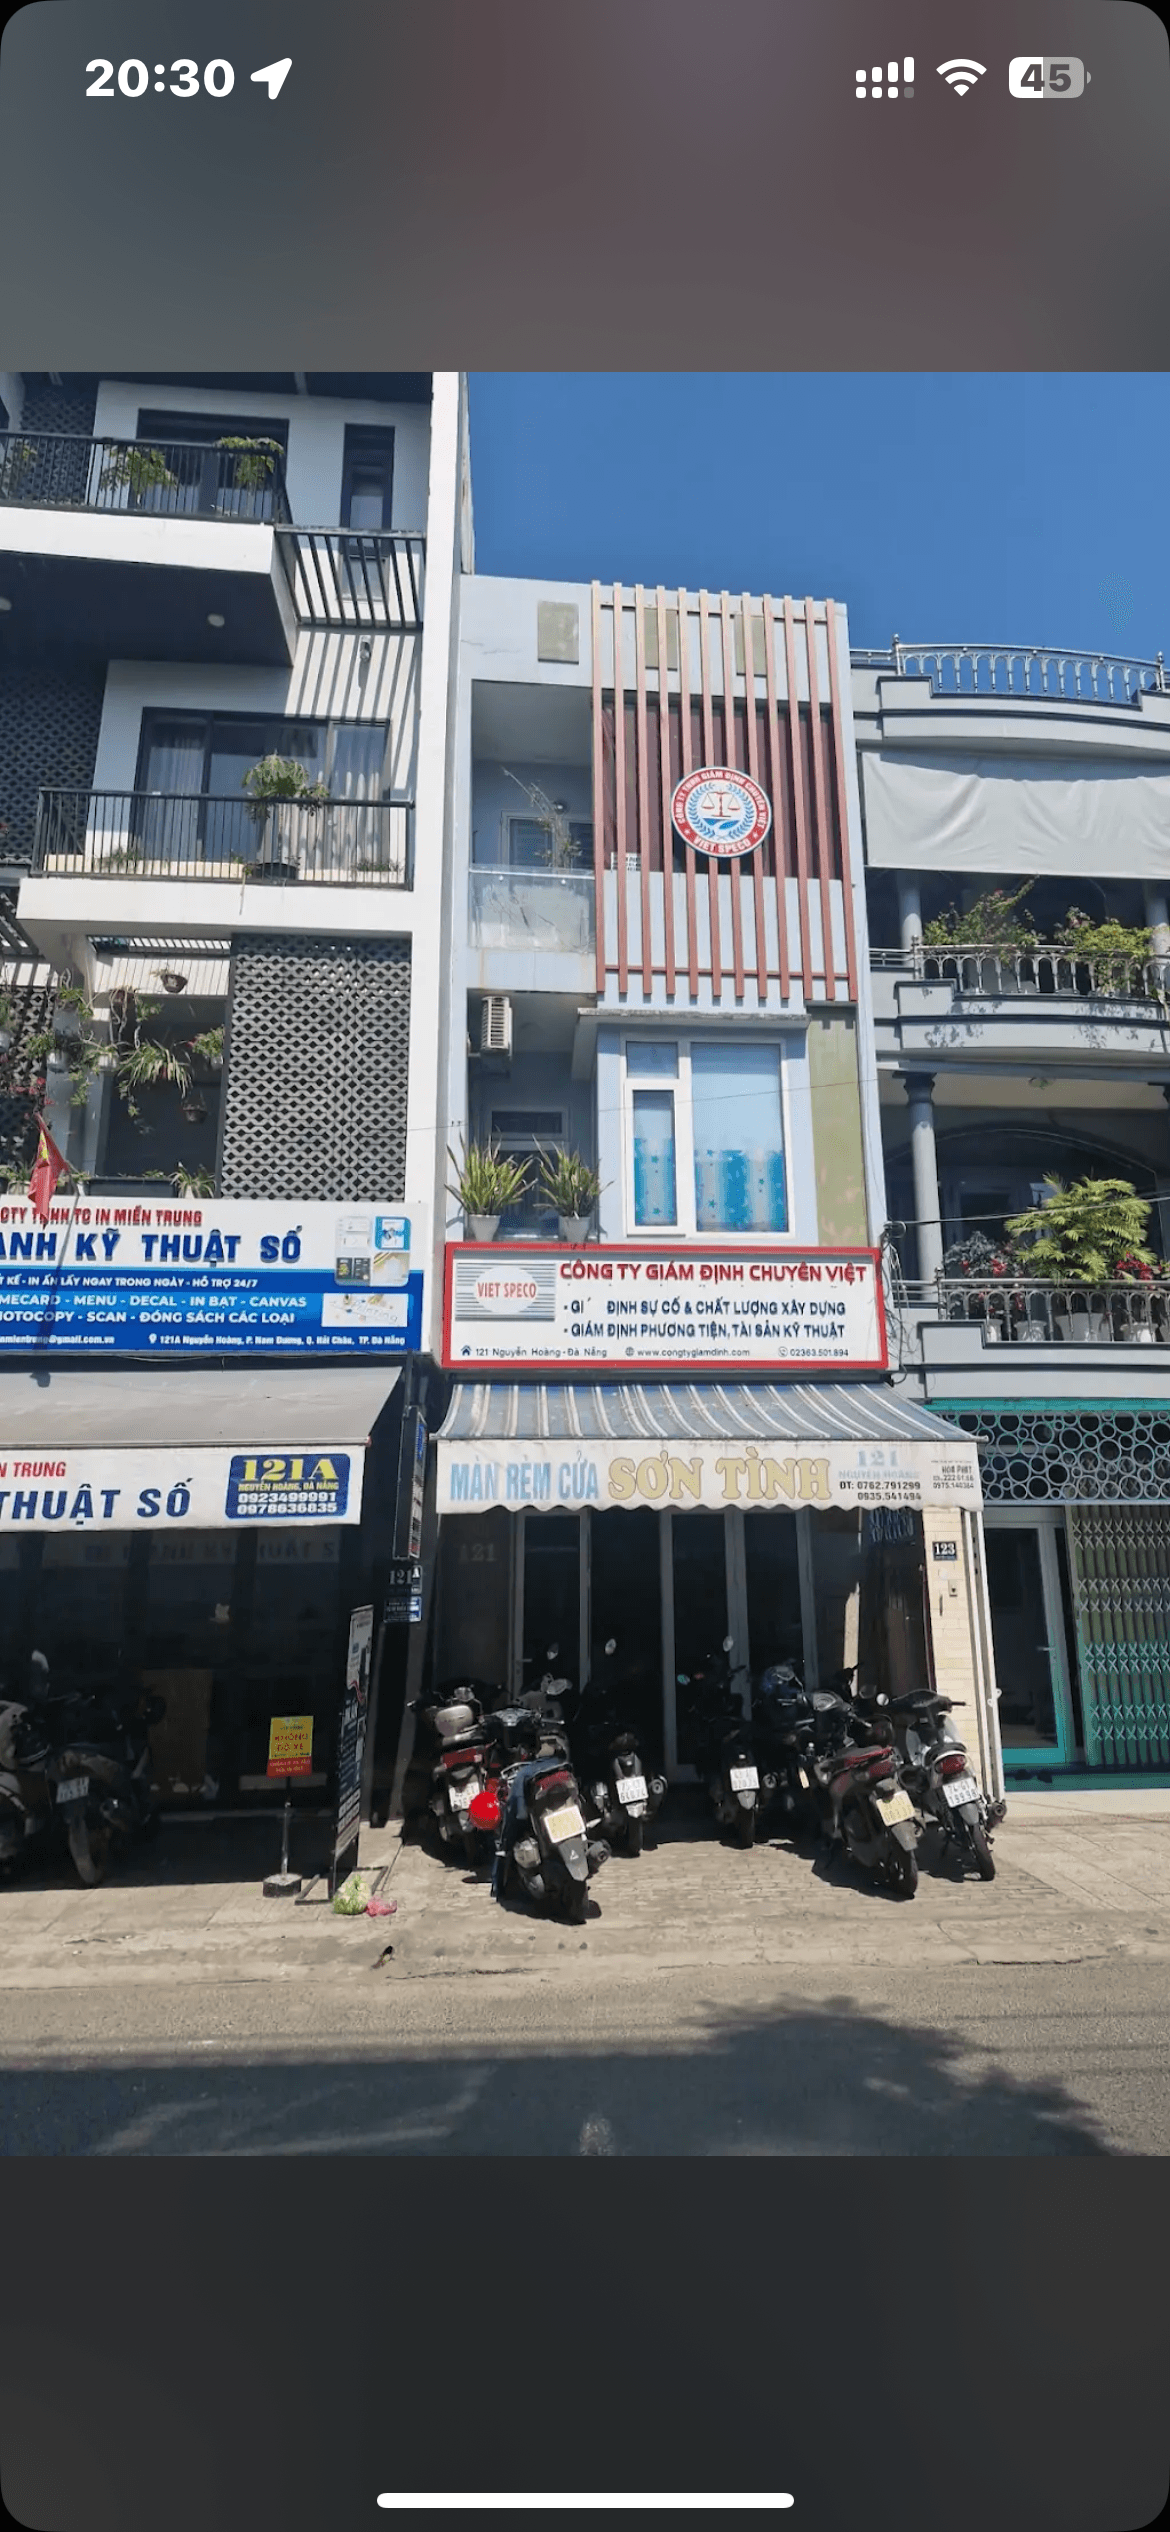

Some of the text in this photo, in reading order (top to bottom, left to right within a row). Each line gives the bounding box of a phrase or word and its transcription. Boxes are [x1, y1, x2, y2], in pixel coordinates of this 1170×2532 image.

[693, 835, 752, 854] VIET SPECO
[32, 1207, 70, 1224] THH
[95, 1208, 110, 1225] IN
[156, 1210, 203, 1227] TRUNG
[75, 1227, 121, 1261] KỸ
[141, 1228, 242, 1268] THUẬT
[260, 1224, 303, 1263] SỐ
[560, 1258, 867, 1286] CÔNG TY GIÁM ĐỊNH CHUYÊN VIỆT
[6, 1272, 22, 1286] KẾ
[28, 1276, 40, 1286] IN
[60, 1273, 80, 1287] LẤY
[82, 1277, 113, 1287] NGAY
[115, 1277, 151, 1288] TRONG
[153, 1275, 185, 1288] NGÀY
[211, 1278, 232, 1290] TRỢ
[233, 1278, 259, 1289] 24/7
[477, 1282, 537, 1298] VIET SPECO
[73, 1294, 118, 1306] MENU
[129, 1295, 178, 1307] DECAL
[189, 1296, 206, 1307] IN
[208, 1296, 238, 1310] BẠT
[249, 1296, 307, 1308] CANVAS
[607, 1301, 637, 1318] ĐỊNH
[640, 1301, 658, 1318] SỰ
[661, 1295, 680, 1315] CỐ
[684, 1301, 693, 1315] &
[696, 1296, 730, 1315] CHẤT
[734, 1299, 778, 1318] LƯỢNG
[781, 1299, 806, 1315] XÂY
[810, 1301, 846, 1318] DỰNG
[0, 1311, 75, 1322] OTOCOPY
[87, 1311, 127, 1322] SCAN
[139, 1309, 182, 1323] ĐÓNG
[186, 1309, 226, 1323] SÁCH
[229, 1310, 258, 1323] CÁC
[262, 1313, 295, 1326] LOẠI
[571, 1319, 846, 1341] GIÁM ĐỊNH PHƯƠNG TIỆN, TÀI SẢN KỸ THUẬT
[160, 1335, 181, 1345] 121A
[182, 1333, 214, 1346] Nguyễn
[246, 1335, 254, 1345] P.
[255, 1335, 275, 1345] Nam
[358, 1336, 371, 1346] TP.
[475, 1348, 489, 1356] 121
[492, 1346, 527, 1359] Nguyễn
[584, 1346, 607, 1358] Nẵng
[637, 1348, 750, 1359] www.congtygiamdinh.com
[790, 1348, 849, 1358] 02363.501.894
[858, 1450, 899, 1467] 121
[14, 1461, 67, 1478] TRUNG
[240, 1457, 340, 1482] 121A
[558, 1449, 600, 1500] CỬA
[608, 1449, 704, 1501] SƠN
[715, 1445, 833, 1501] TÌNH
[238, 1479, 339, 1492] NGUYỄN HOÀNG, ĐÀ NẴNG
[136, 1477, 194, 1518] SỐ
[238, 1491, 336, 1504] 0923499991
[237, 1502, 338, 1515] 0978636835
[934, 1542, 956, 1556] 123
